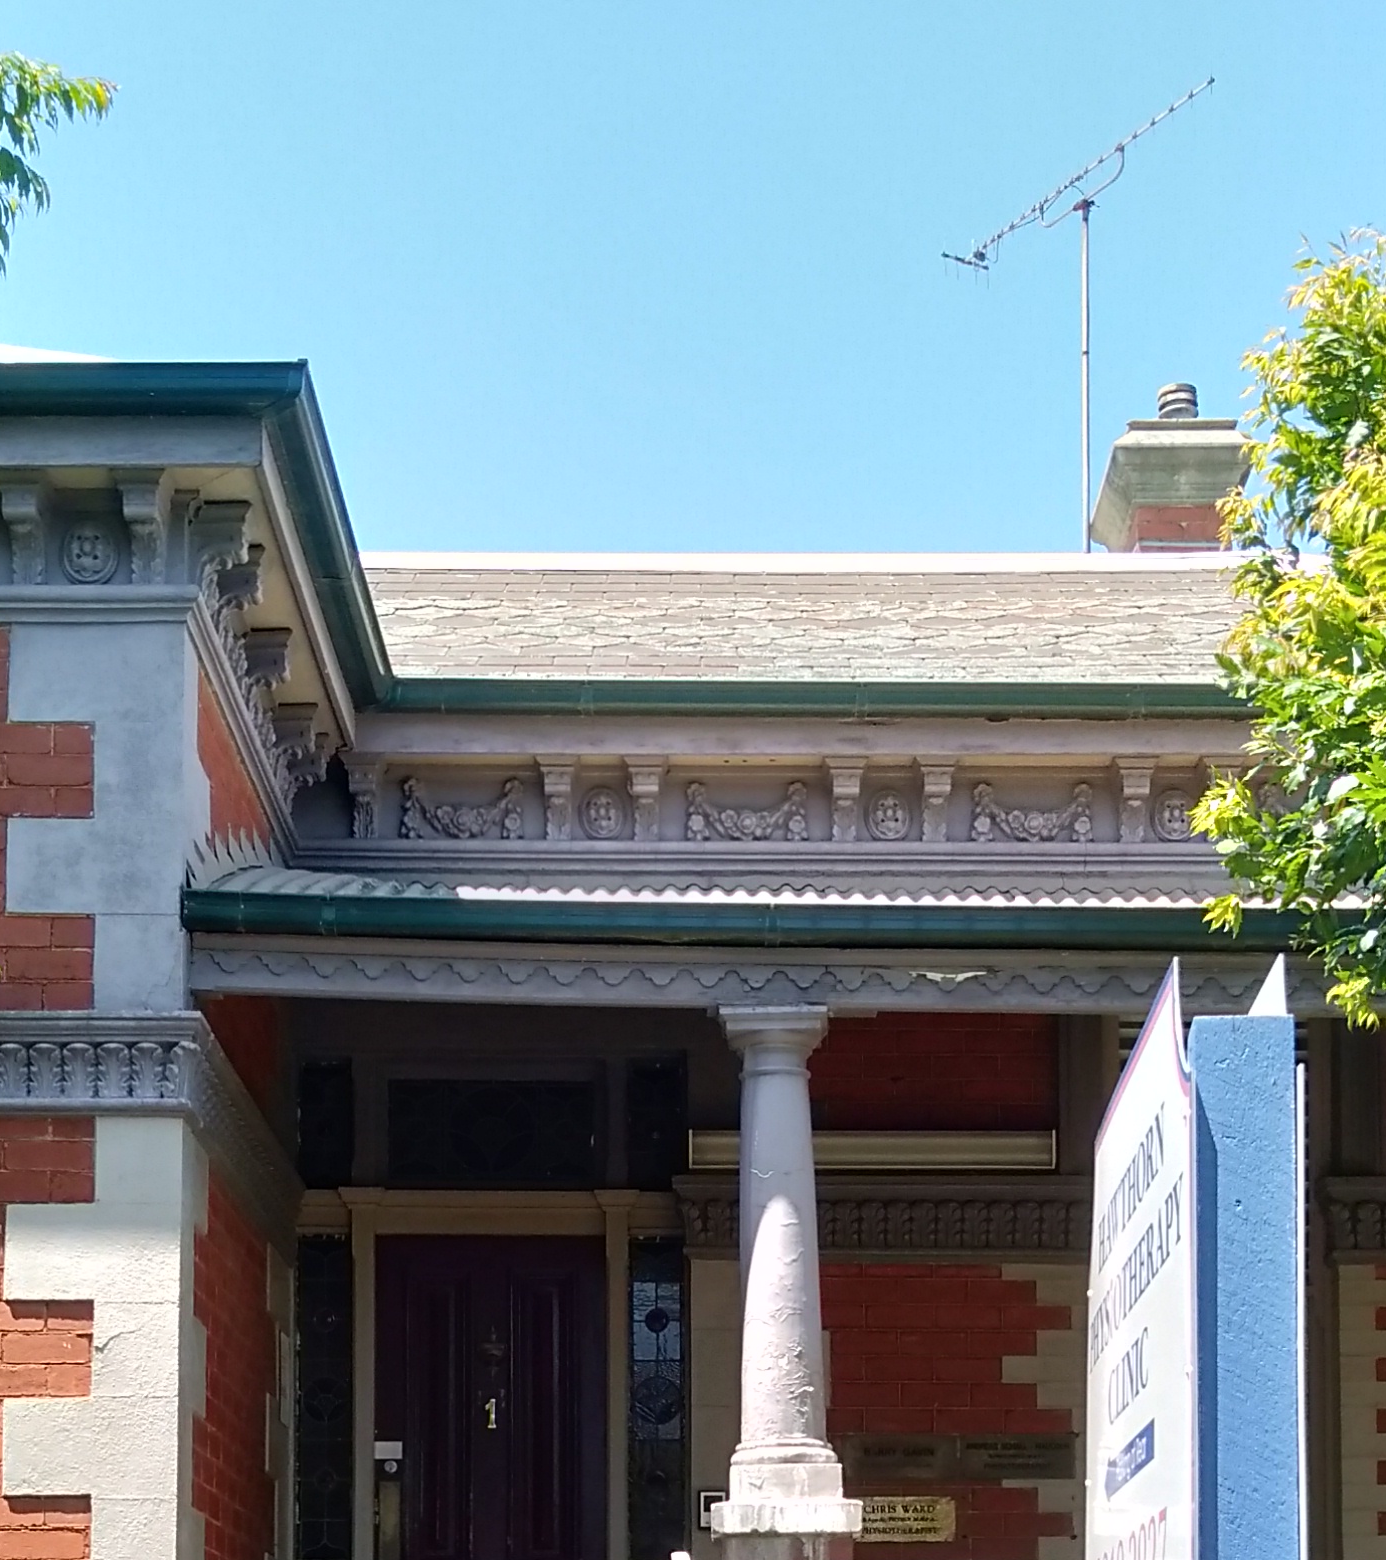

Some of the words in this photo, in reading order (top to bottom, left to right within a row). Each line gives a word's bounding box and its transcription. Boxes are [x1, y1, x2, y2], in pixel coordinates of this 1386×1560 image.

[1098, 1101, 1165, 1275] HAWTHORN
[1108, 1326, 1149, 1425] CLINIC
[485, 1398, 497, 1429] 1
[863, 1504, 897, 1514] CHRIS
[901, 1504, 935, 1514] WARD
